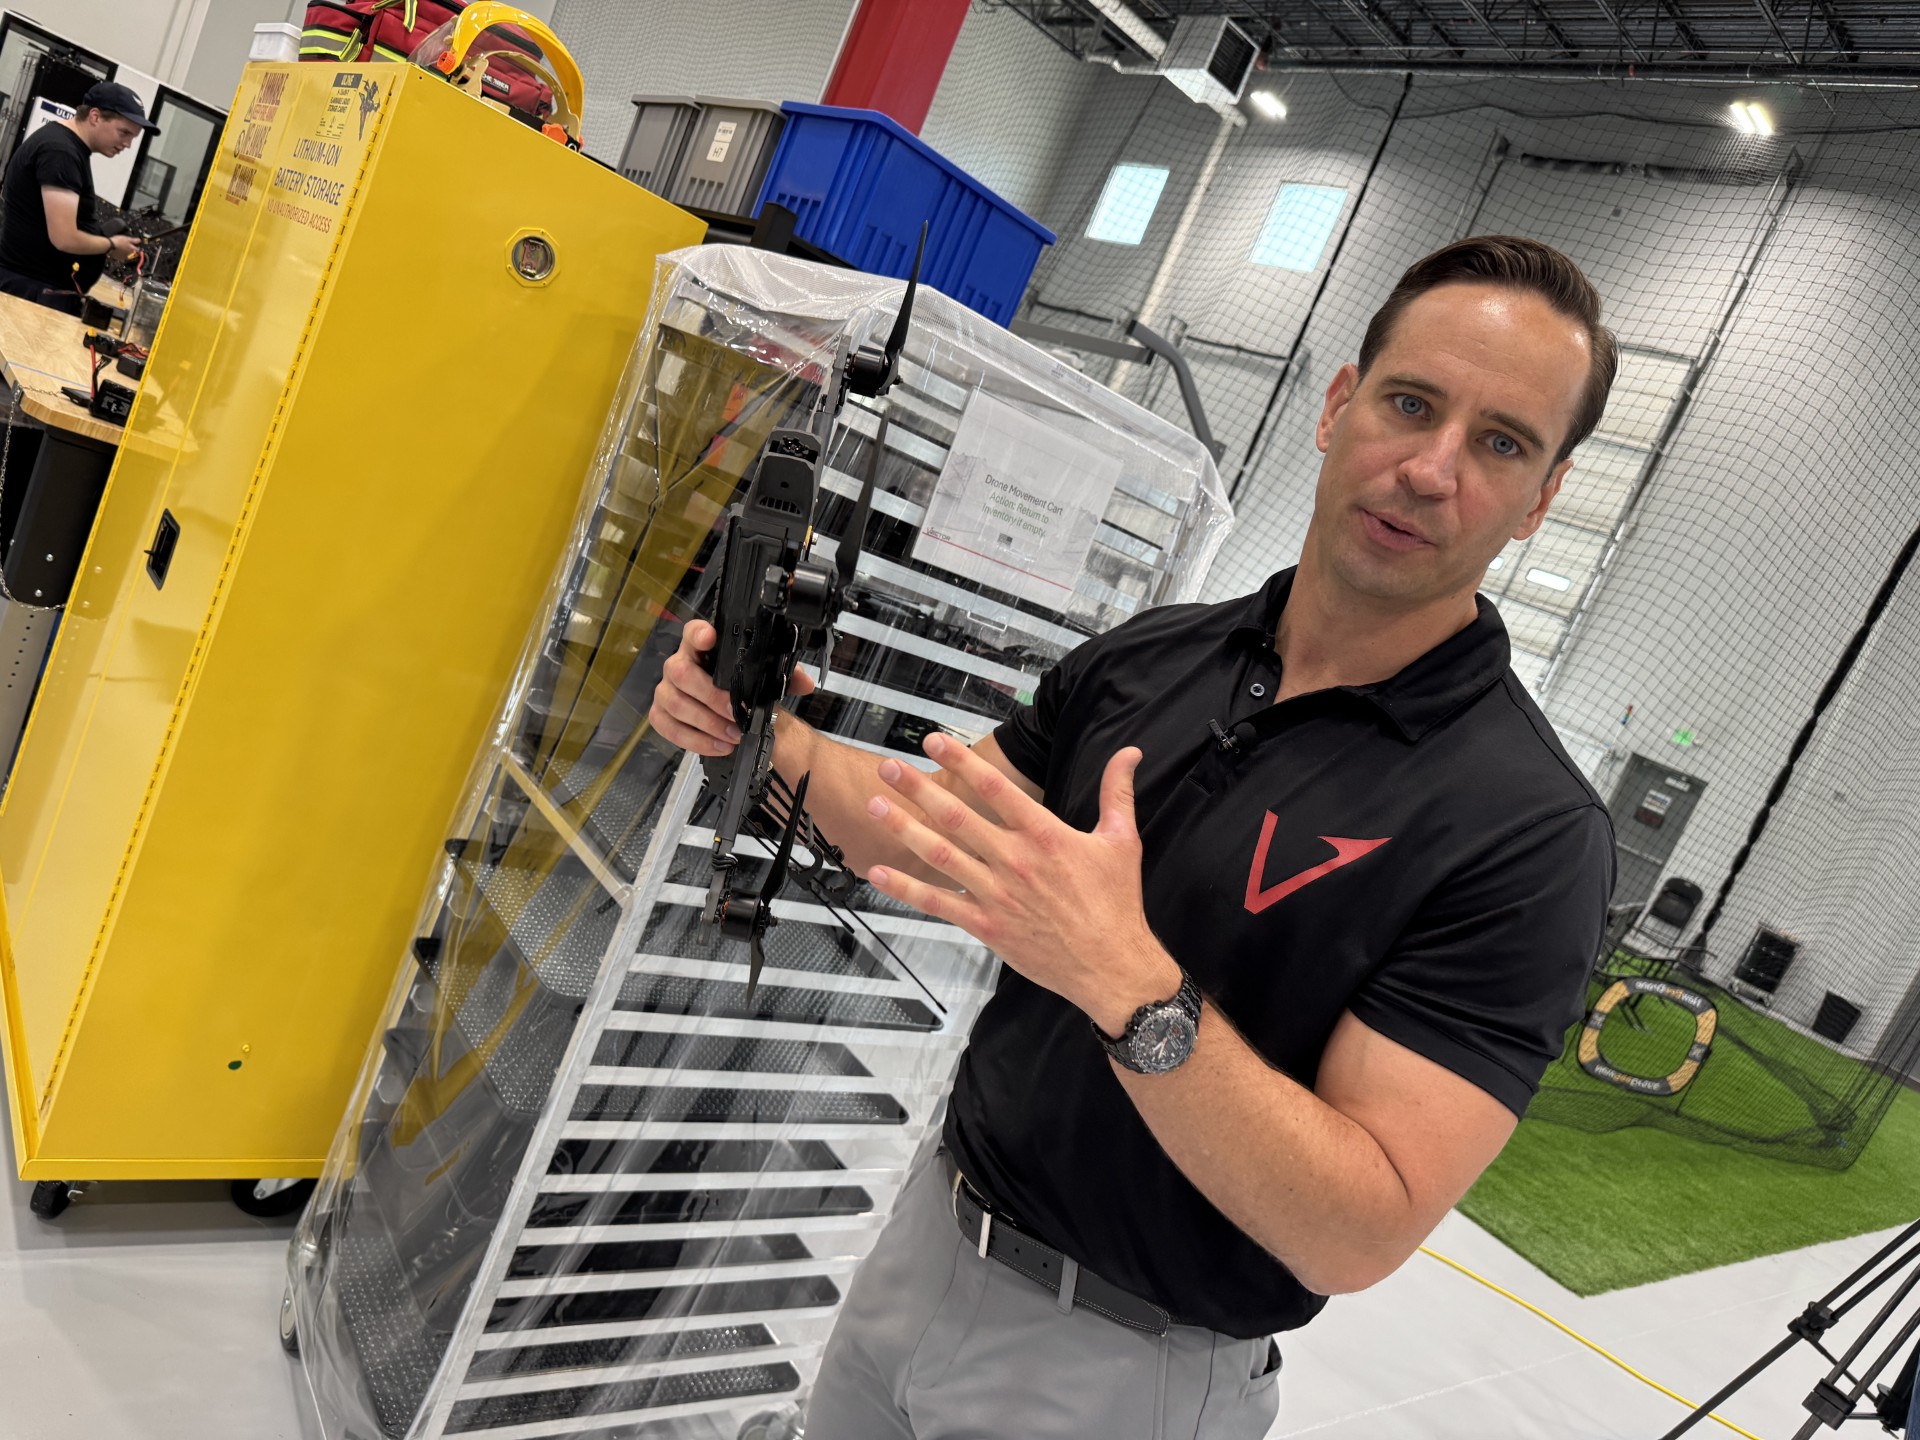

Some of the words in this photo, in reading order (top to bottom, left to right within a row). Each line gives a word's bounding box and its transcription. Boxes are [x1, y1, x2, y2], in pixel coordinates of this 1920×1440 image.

[56, 108, 76, 120] ULIN
[293, 137, 342, 167] LITHIUM-ION
[274, 167, 306, 194] BATTERY
[304, 175, 345, 206] STORAGE
[309, 209, 332, 234] ACCESS
[985, 474, 1008, 492] Drone
[1008, 484, 1047, 509] Movement
[1046, 502, 1064, 517] Cart
[989, 491, 1016, 511] Action:
[1016, 503, 1042, 521] Return
[1042, 514, 1050, 524] to
[981, 503, 1018, 526] Inventory
